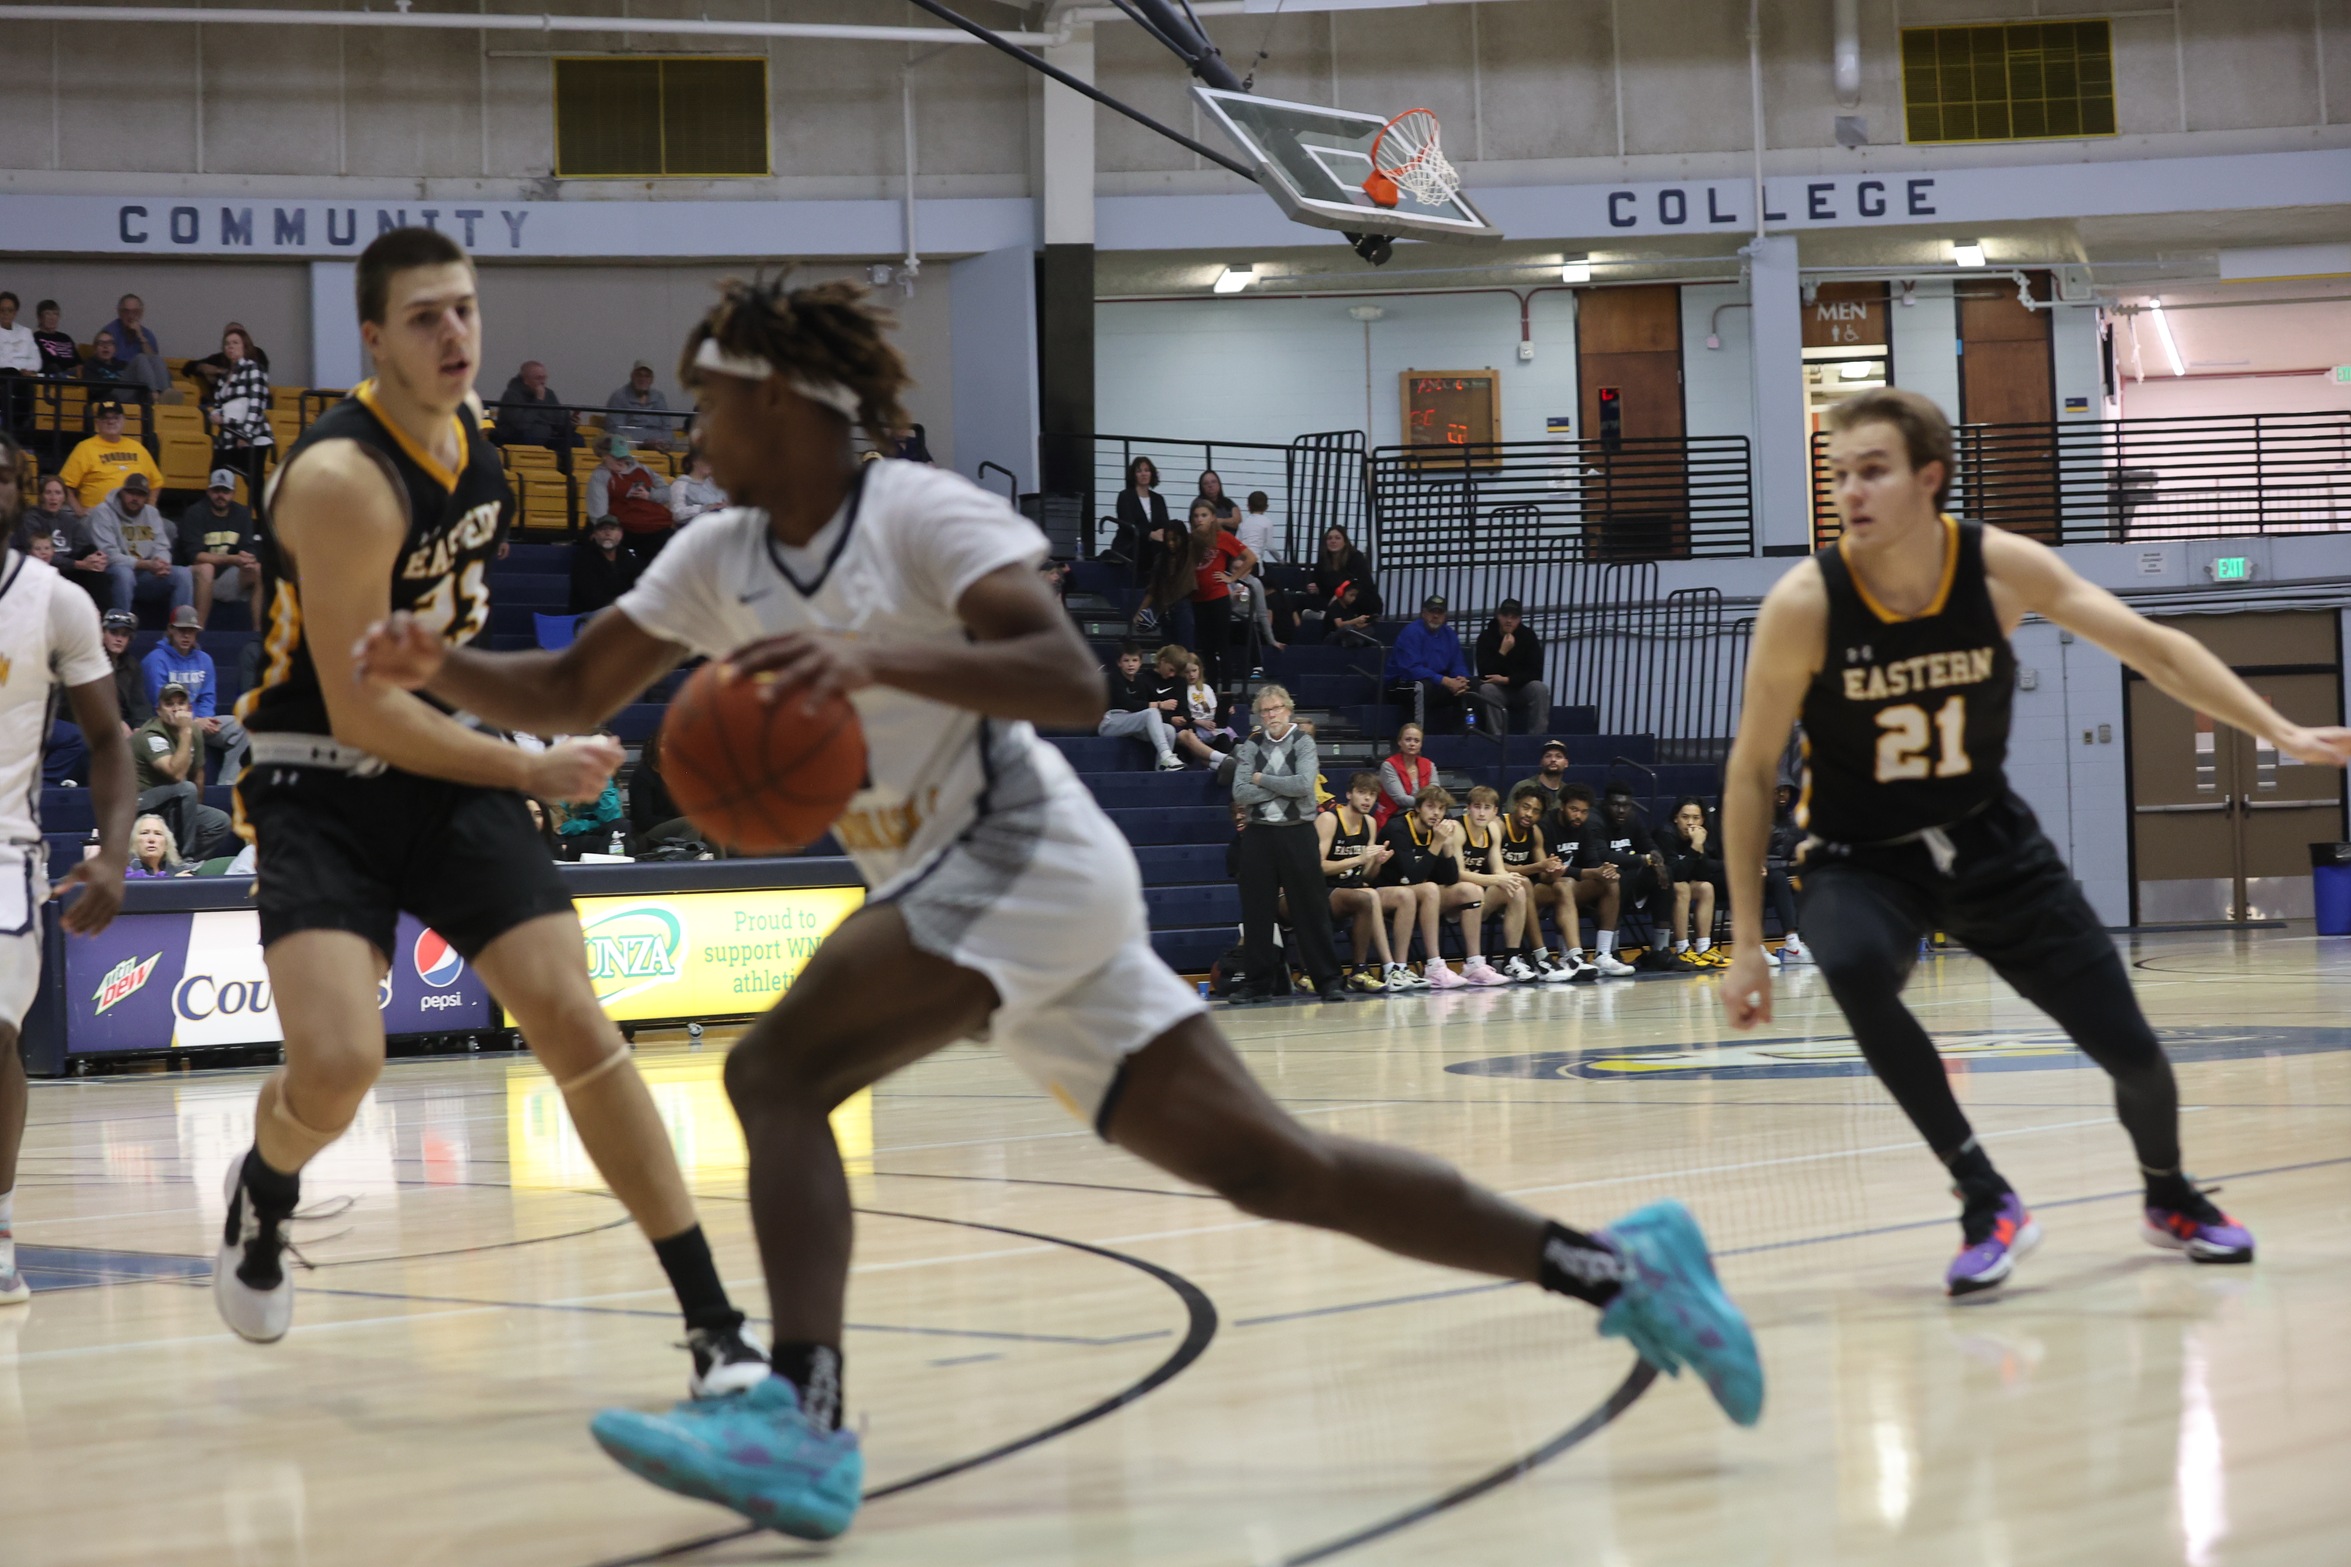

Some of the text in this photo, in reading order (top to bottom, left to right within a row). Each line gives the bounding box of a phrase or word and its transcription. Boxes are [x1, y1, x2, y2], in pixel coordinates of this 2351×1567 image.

[1607, 178, 1937, 228] COLLEGE
[118, 205, 530, 249] COMMUNITY
[1816, 302, 1868, 322] MEN
[2218, 557, 2245, 579] EXIT
[1842, 647, 1995, 701] EASTERN
[1873, 694, 1973, 784] 21
[734, 907, 817, 932] Proud to
[584, 934, 676, 981] UNZA
[704, 936, 822, 967] support WN
[733, 968, 797, 994] athleti
[420, 992, 462, 1012] pepsi
